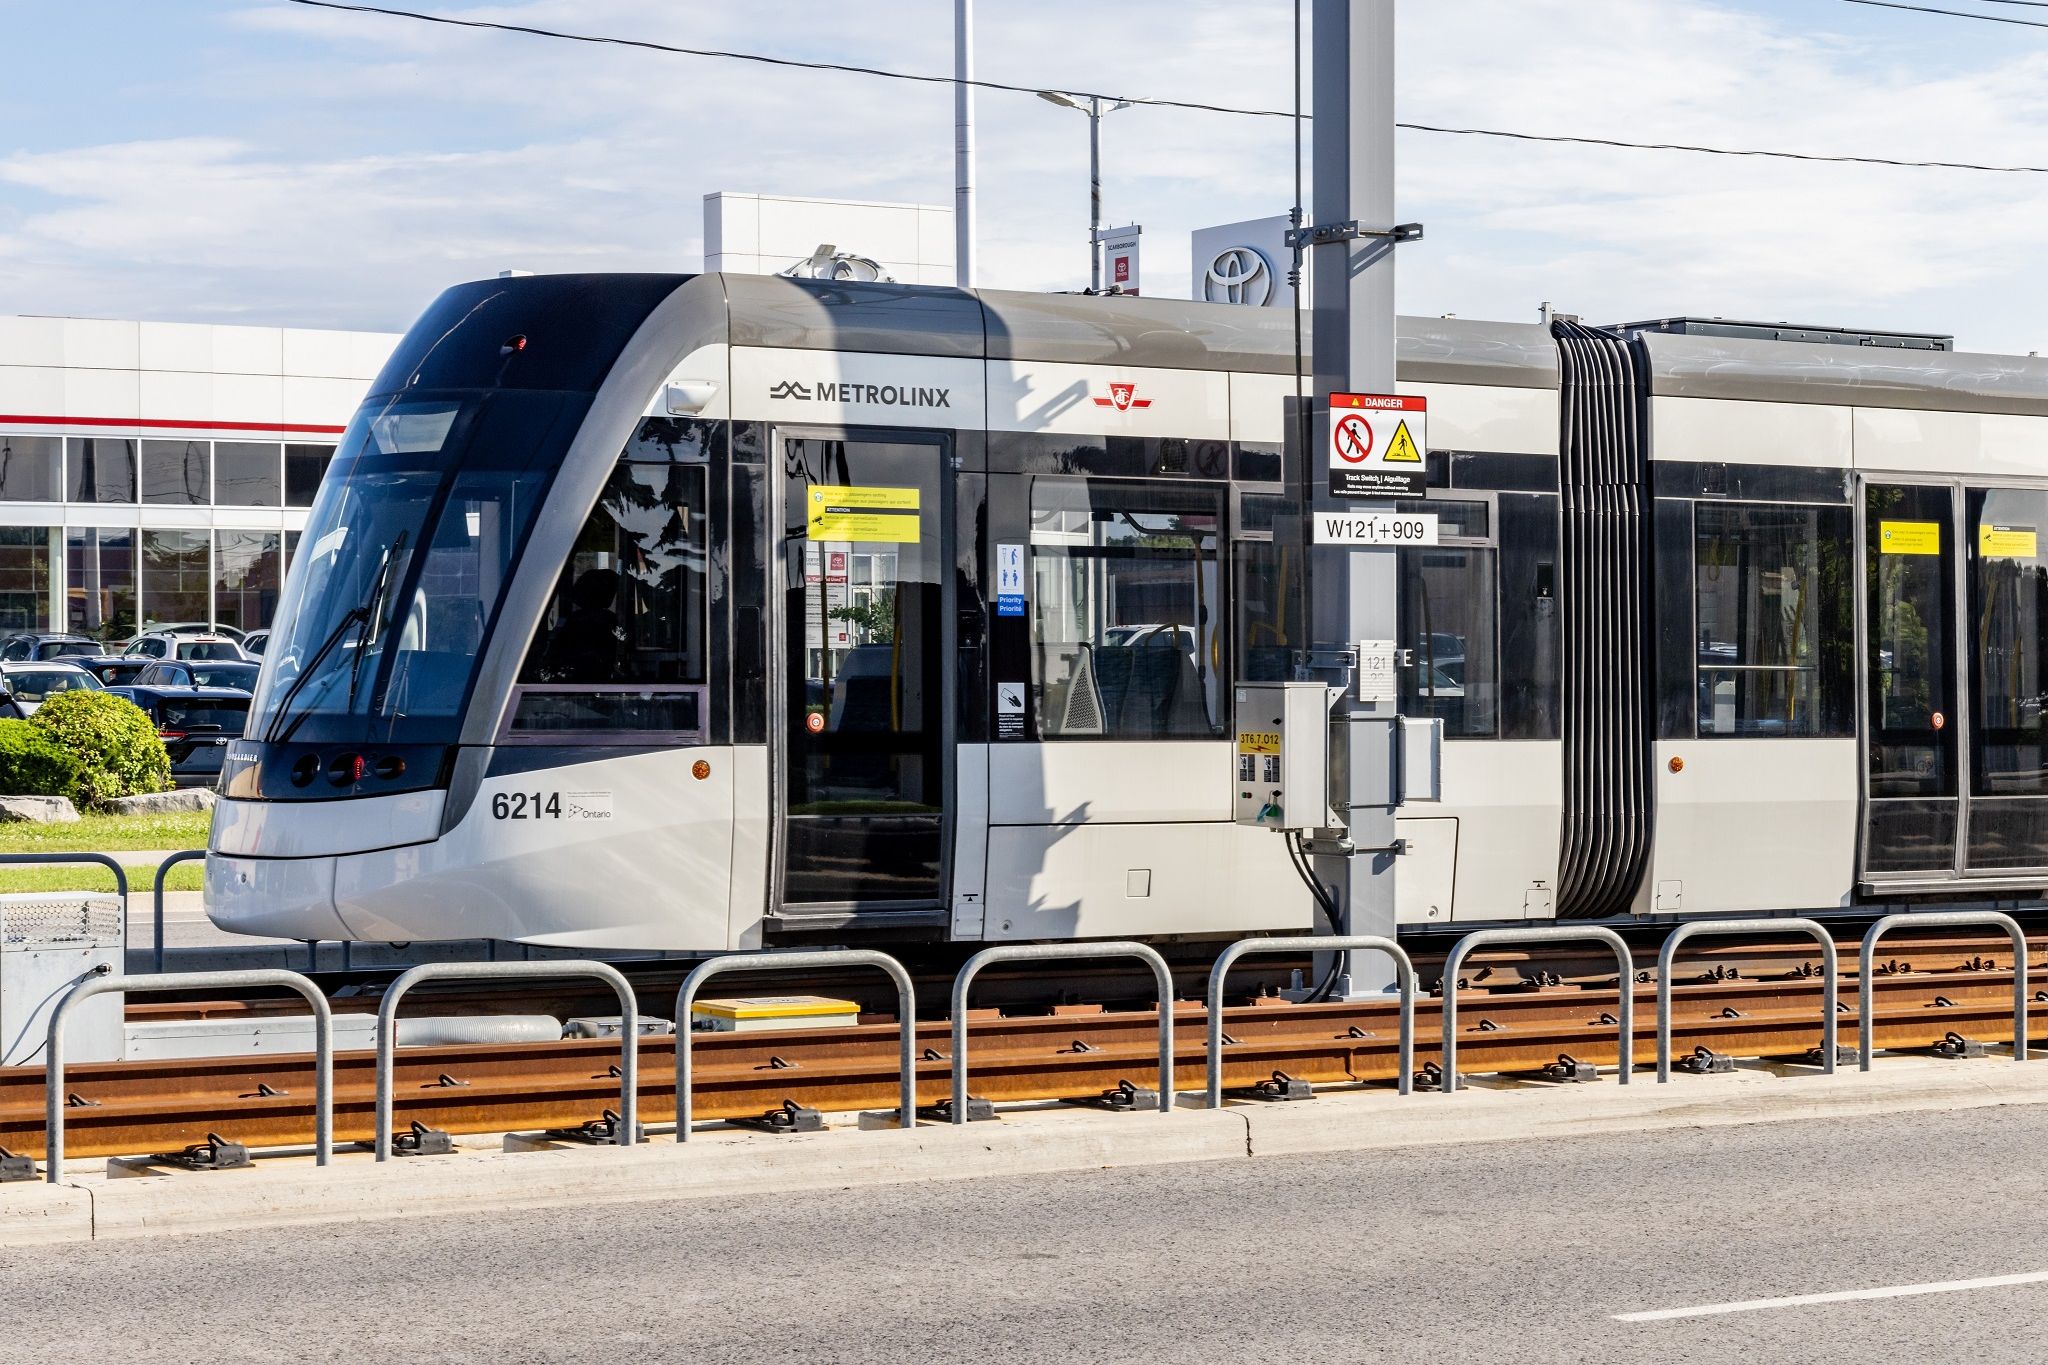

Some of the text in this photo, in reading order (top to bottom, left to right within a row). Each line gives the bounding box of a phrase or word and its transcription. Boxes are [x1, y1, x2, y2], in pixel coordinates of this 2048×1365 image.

[1108, 242, 1136, 250] SCARBOROUGH
[817, 382, 951, 408] METROLINX
[1365, 397, 1403, 408] DANGER
[1345, 473, 1411, 484] Track Switch Aiguillage
[1326, 519, 1424, 540] W121+909
[1367, 656, 1386, 670] 121
[492, 792, 562, 820] 6214
[582, 810, 611, 818] Ontario
